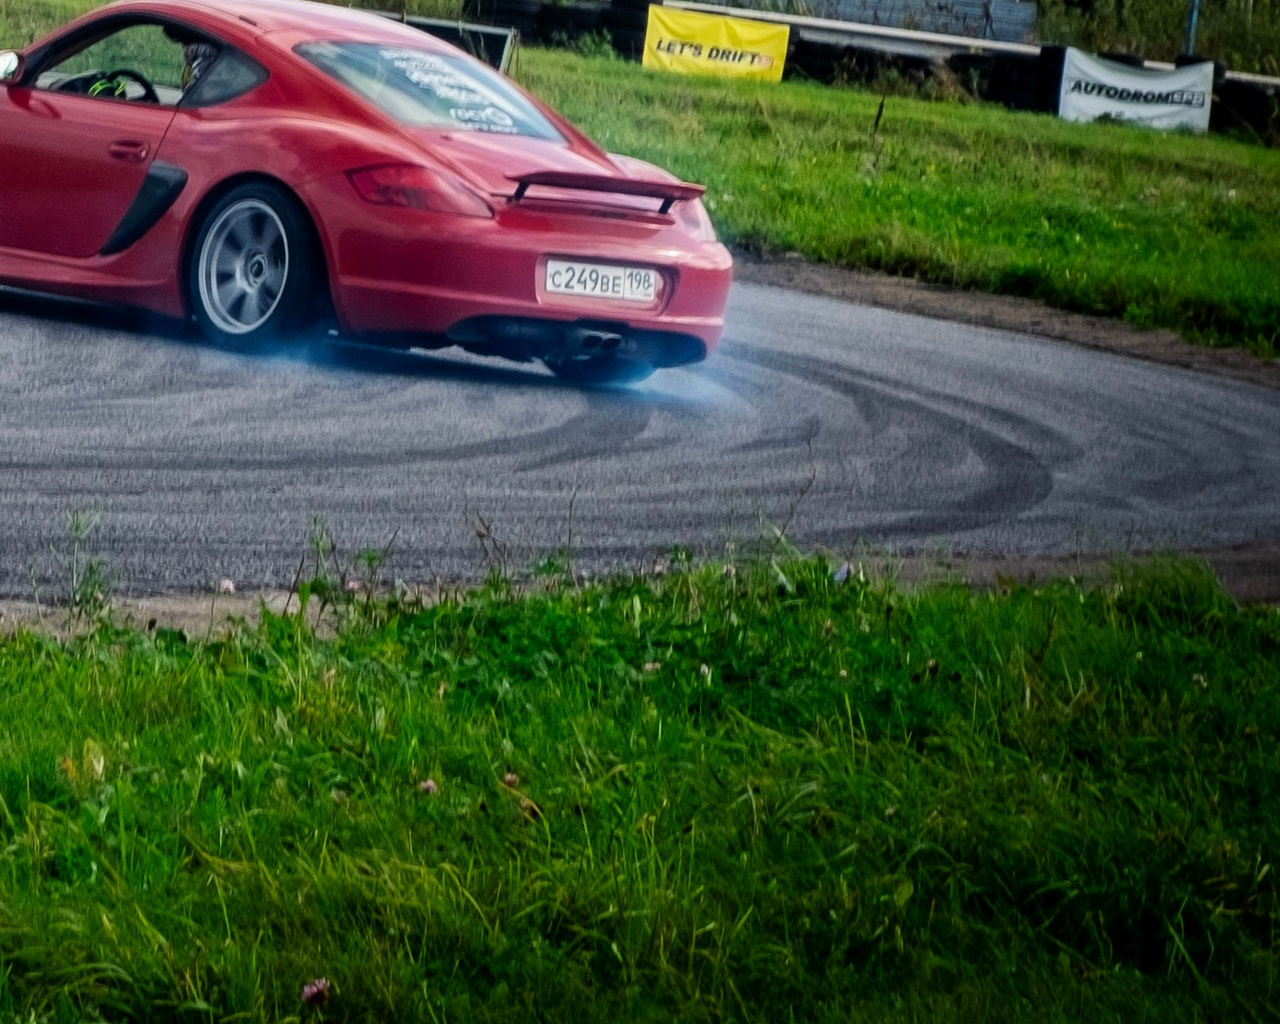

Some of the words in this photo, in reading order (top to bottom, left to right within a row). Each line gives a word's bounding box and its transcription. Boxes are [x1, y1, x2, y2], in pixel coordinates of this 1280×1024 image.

[656, 38, 703, 57] LET'S
[707, 46, 759, 65] DRIFT
[626, 270, 652, 290] 198
